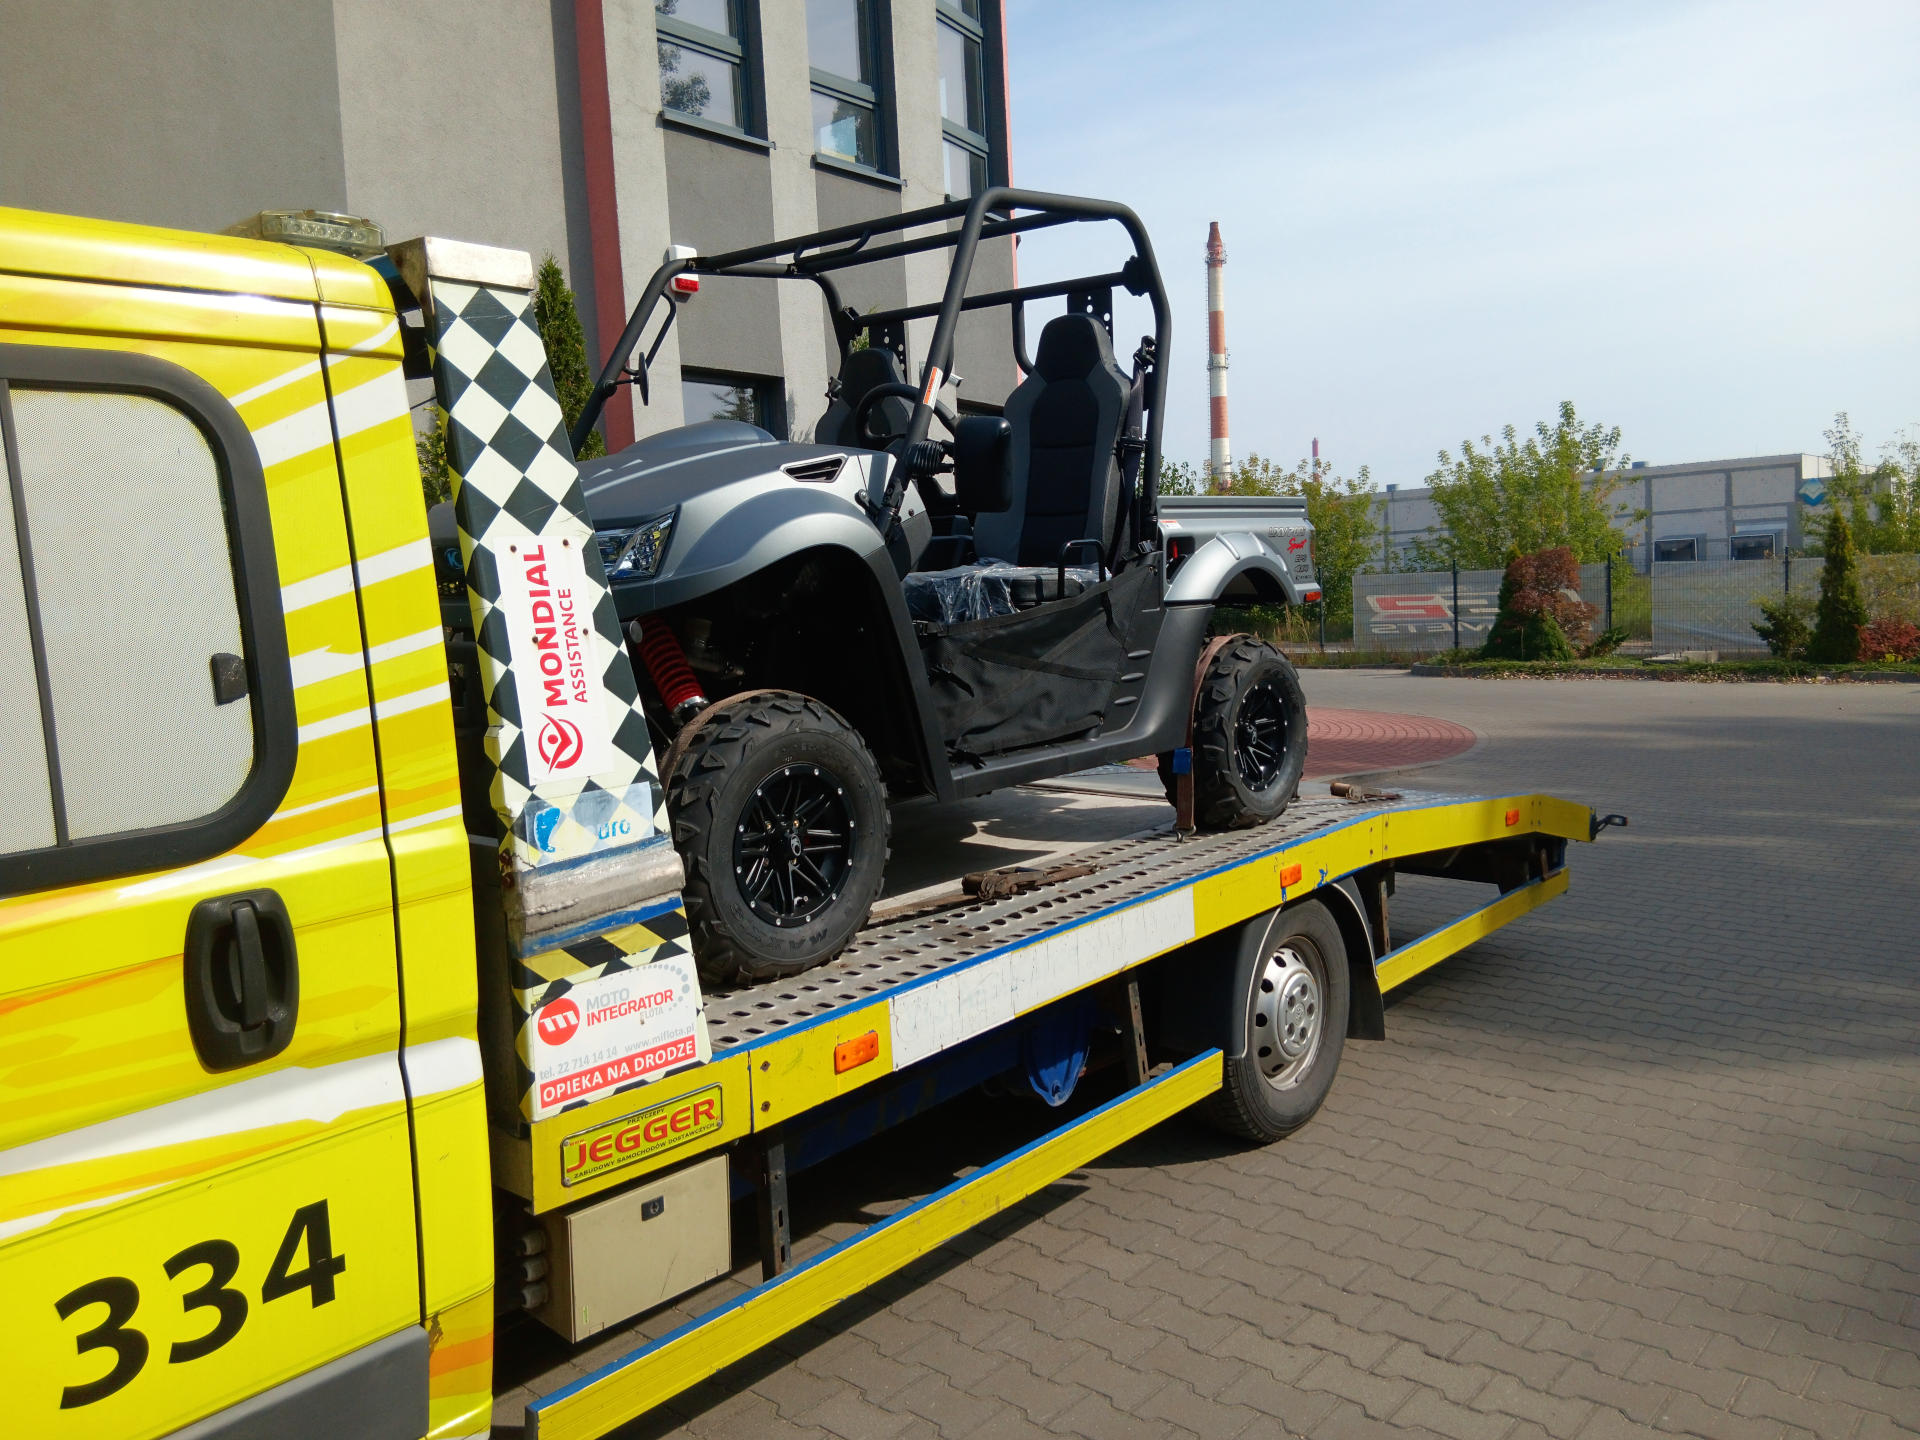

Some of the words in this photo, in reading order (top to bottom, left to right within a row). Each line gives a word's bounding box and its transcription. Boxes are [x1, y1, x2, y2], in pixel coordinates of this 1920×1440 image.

[523, 544, 568, 707] MONDIAL
[557, 588, 588, 703] ASSISTANCE
[586, 987, 630, 1012] MOTO
[586, 988, 674, 1027] INTEGRATOR
[539, 1066, 556, 1081] tel.
[557, 1062, 570, 1075] 22
[571, 1054, 590, 1070] 714
[592, 1050, 604, 1064] 14
[542, 1075, 603, 1102] OPIEKA
[607, 1061, 630, 1080] NA
[634, 1040, 695, 1073] DRODZE
[566, 1098, 717, 1173] JEGGER
[627, 1107, 666, 1125] PRZYCZEPY
[573, 1159, 616, 1179] ZABUDOWY
[616, 1141, 667, 1163] SAMOCHODÓW
[668, 1122, 716, 1144] DOSTAWCZYCH
[54, 1198, 347, 1410] 334
